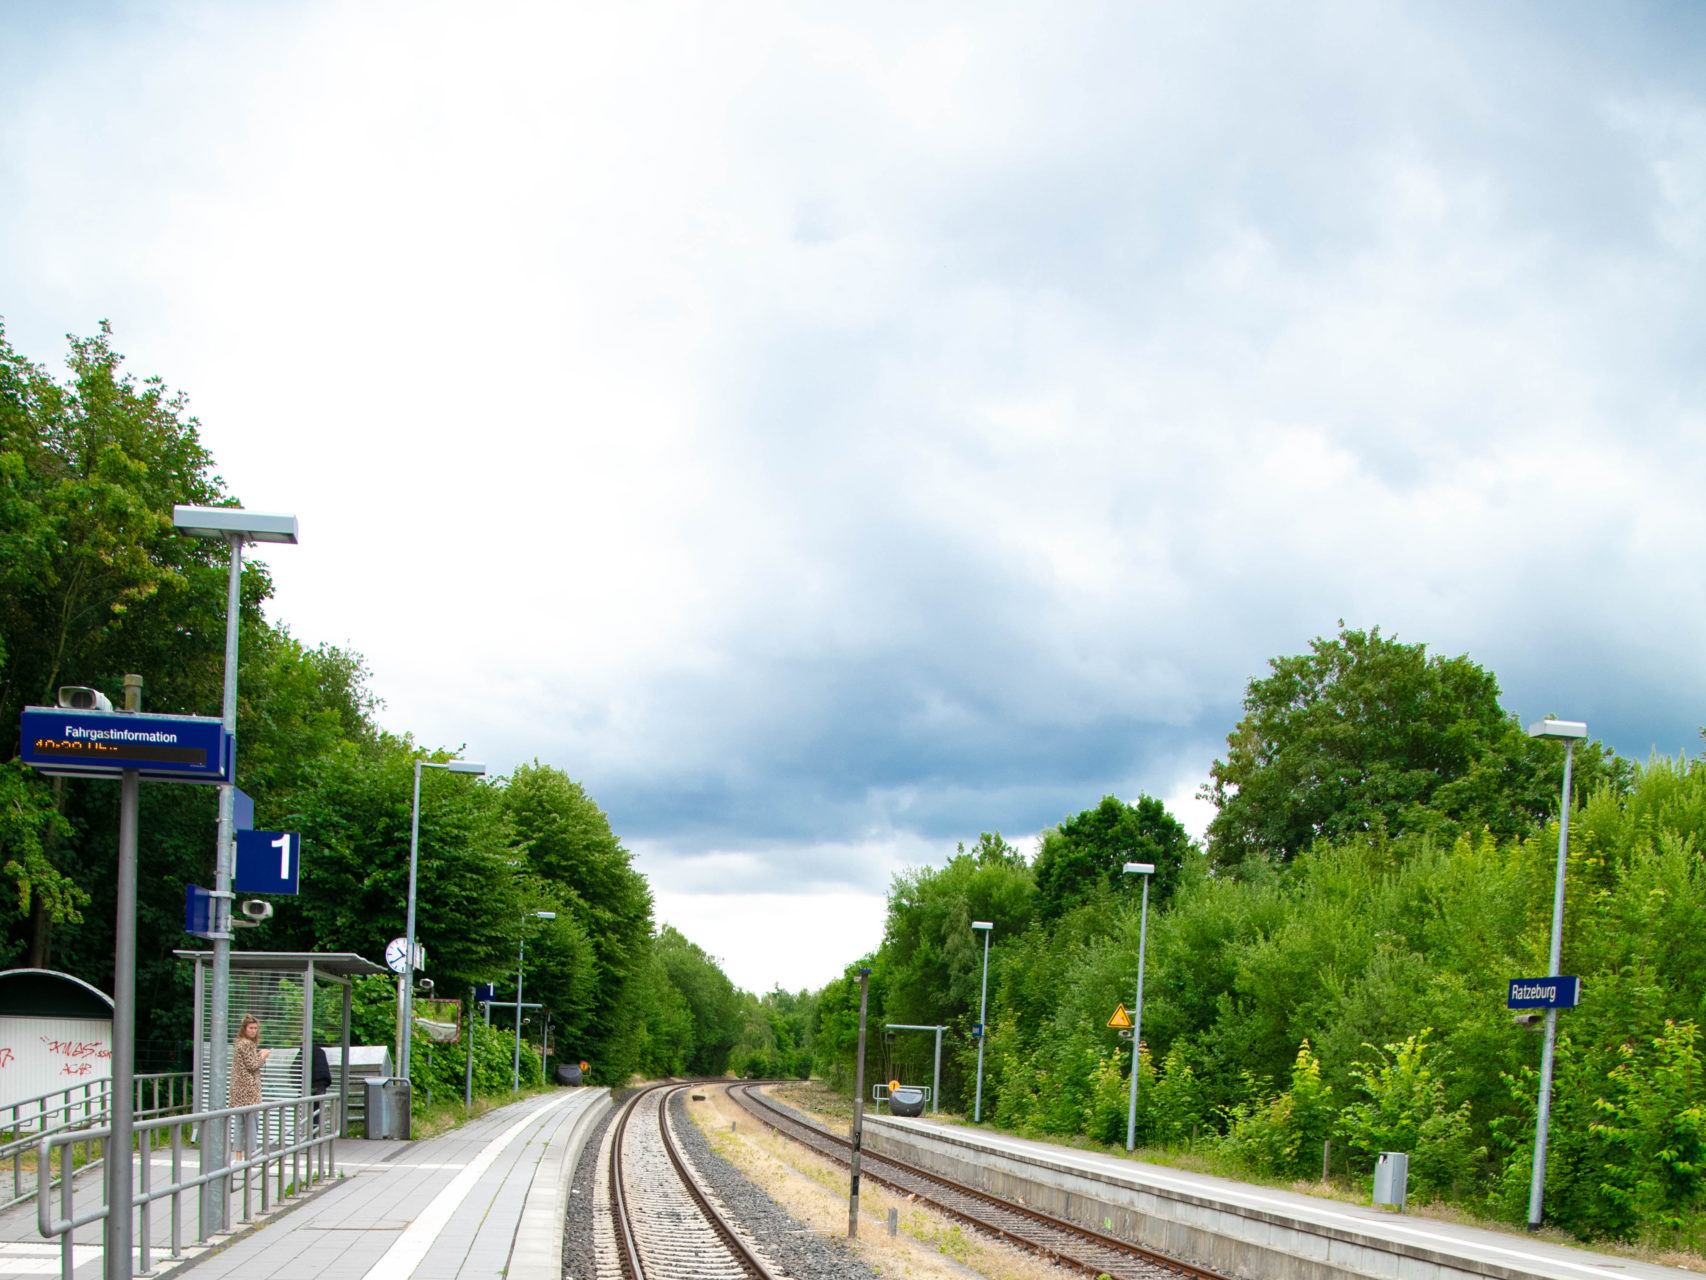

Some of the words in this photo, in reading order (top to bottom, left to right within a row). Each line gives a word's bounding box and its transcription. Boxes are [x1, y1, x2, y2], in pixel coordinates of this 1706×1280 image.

[65, 725, 178, 743] Fahrgastinformation
[271, 833, 291, 880] 1
[1511, 984, 1557, 1003] Ratzeburg
